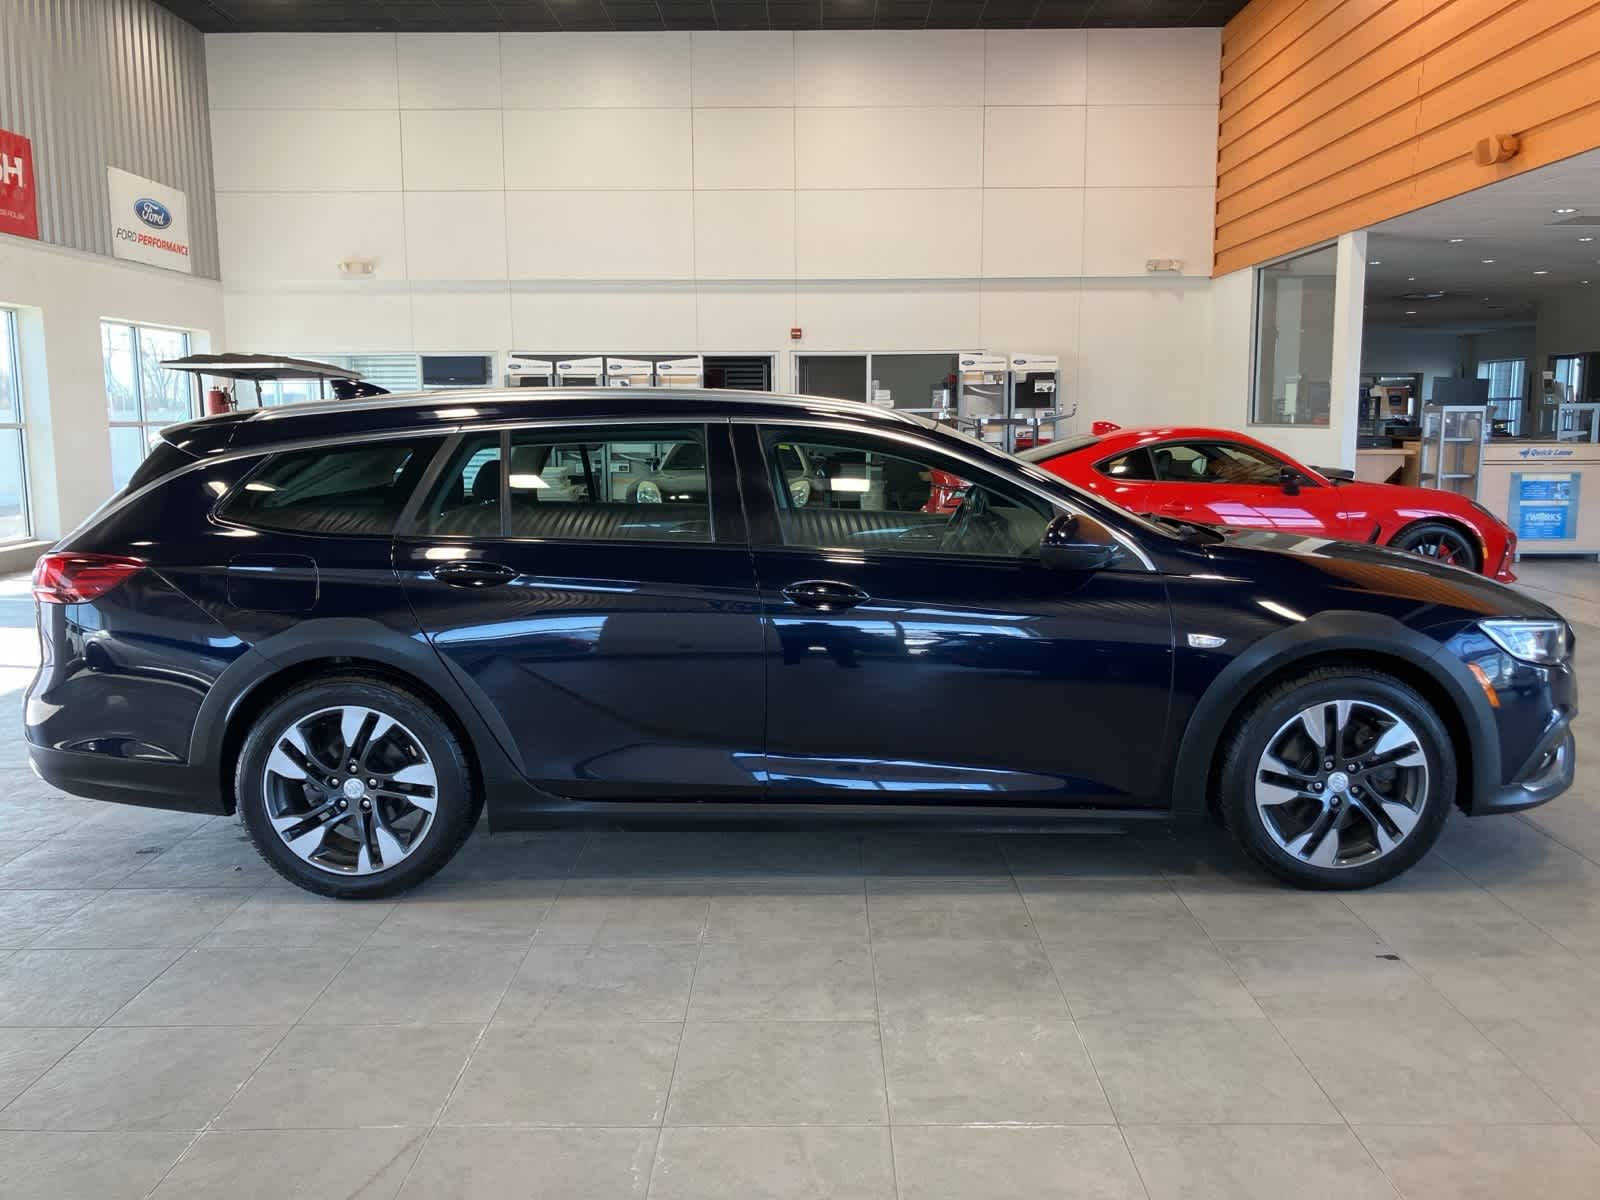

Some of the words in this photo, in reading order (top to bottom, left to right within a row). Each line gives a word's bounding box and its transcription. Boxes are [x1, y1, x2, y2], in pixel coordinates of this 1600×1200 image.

[0, 152, 24, 188] H
[143, 202, 164, 226] Ford
[116, 227, 137, 242] FORD
[138, 233, 189, 256] PERFORMANCE
[1531, 448, 1552, 456] Quick
